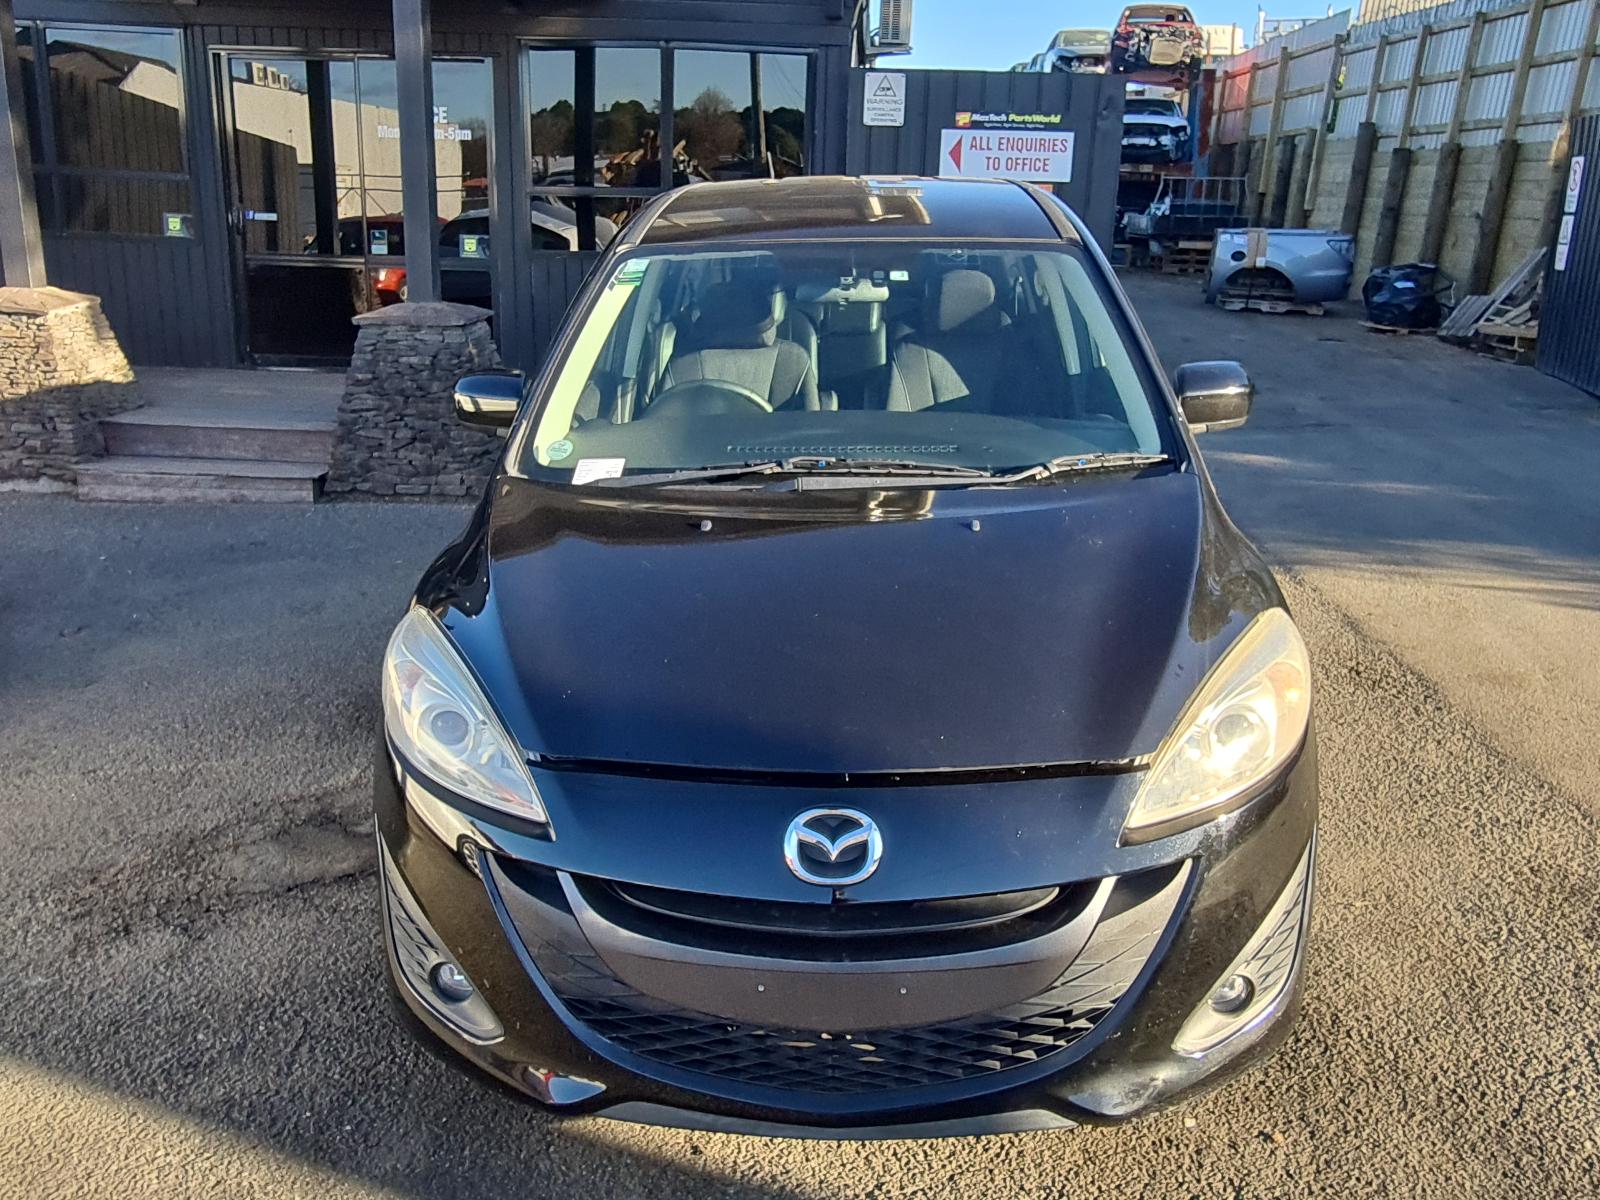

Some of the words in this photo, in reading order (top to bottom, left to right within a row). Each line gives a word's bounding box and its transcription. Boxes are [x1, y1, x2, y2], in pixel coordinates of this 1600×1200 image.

[969, 136, 993, 151] ALL
[997, 136, 1068, 153] ENQUIRIES
[985, 156, 1001, 171] TO
[1005, 157, 1050, 172] OFFICE
